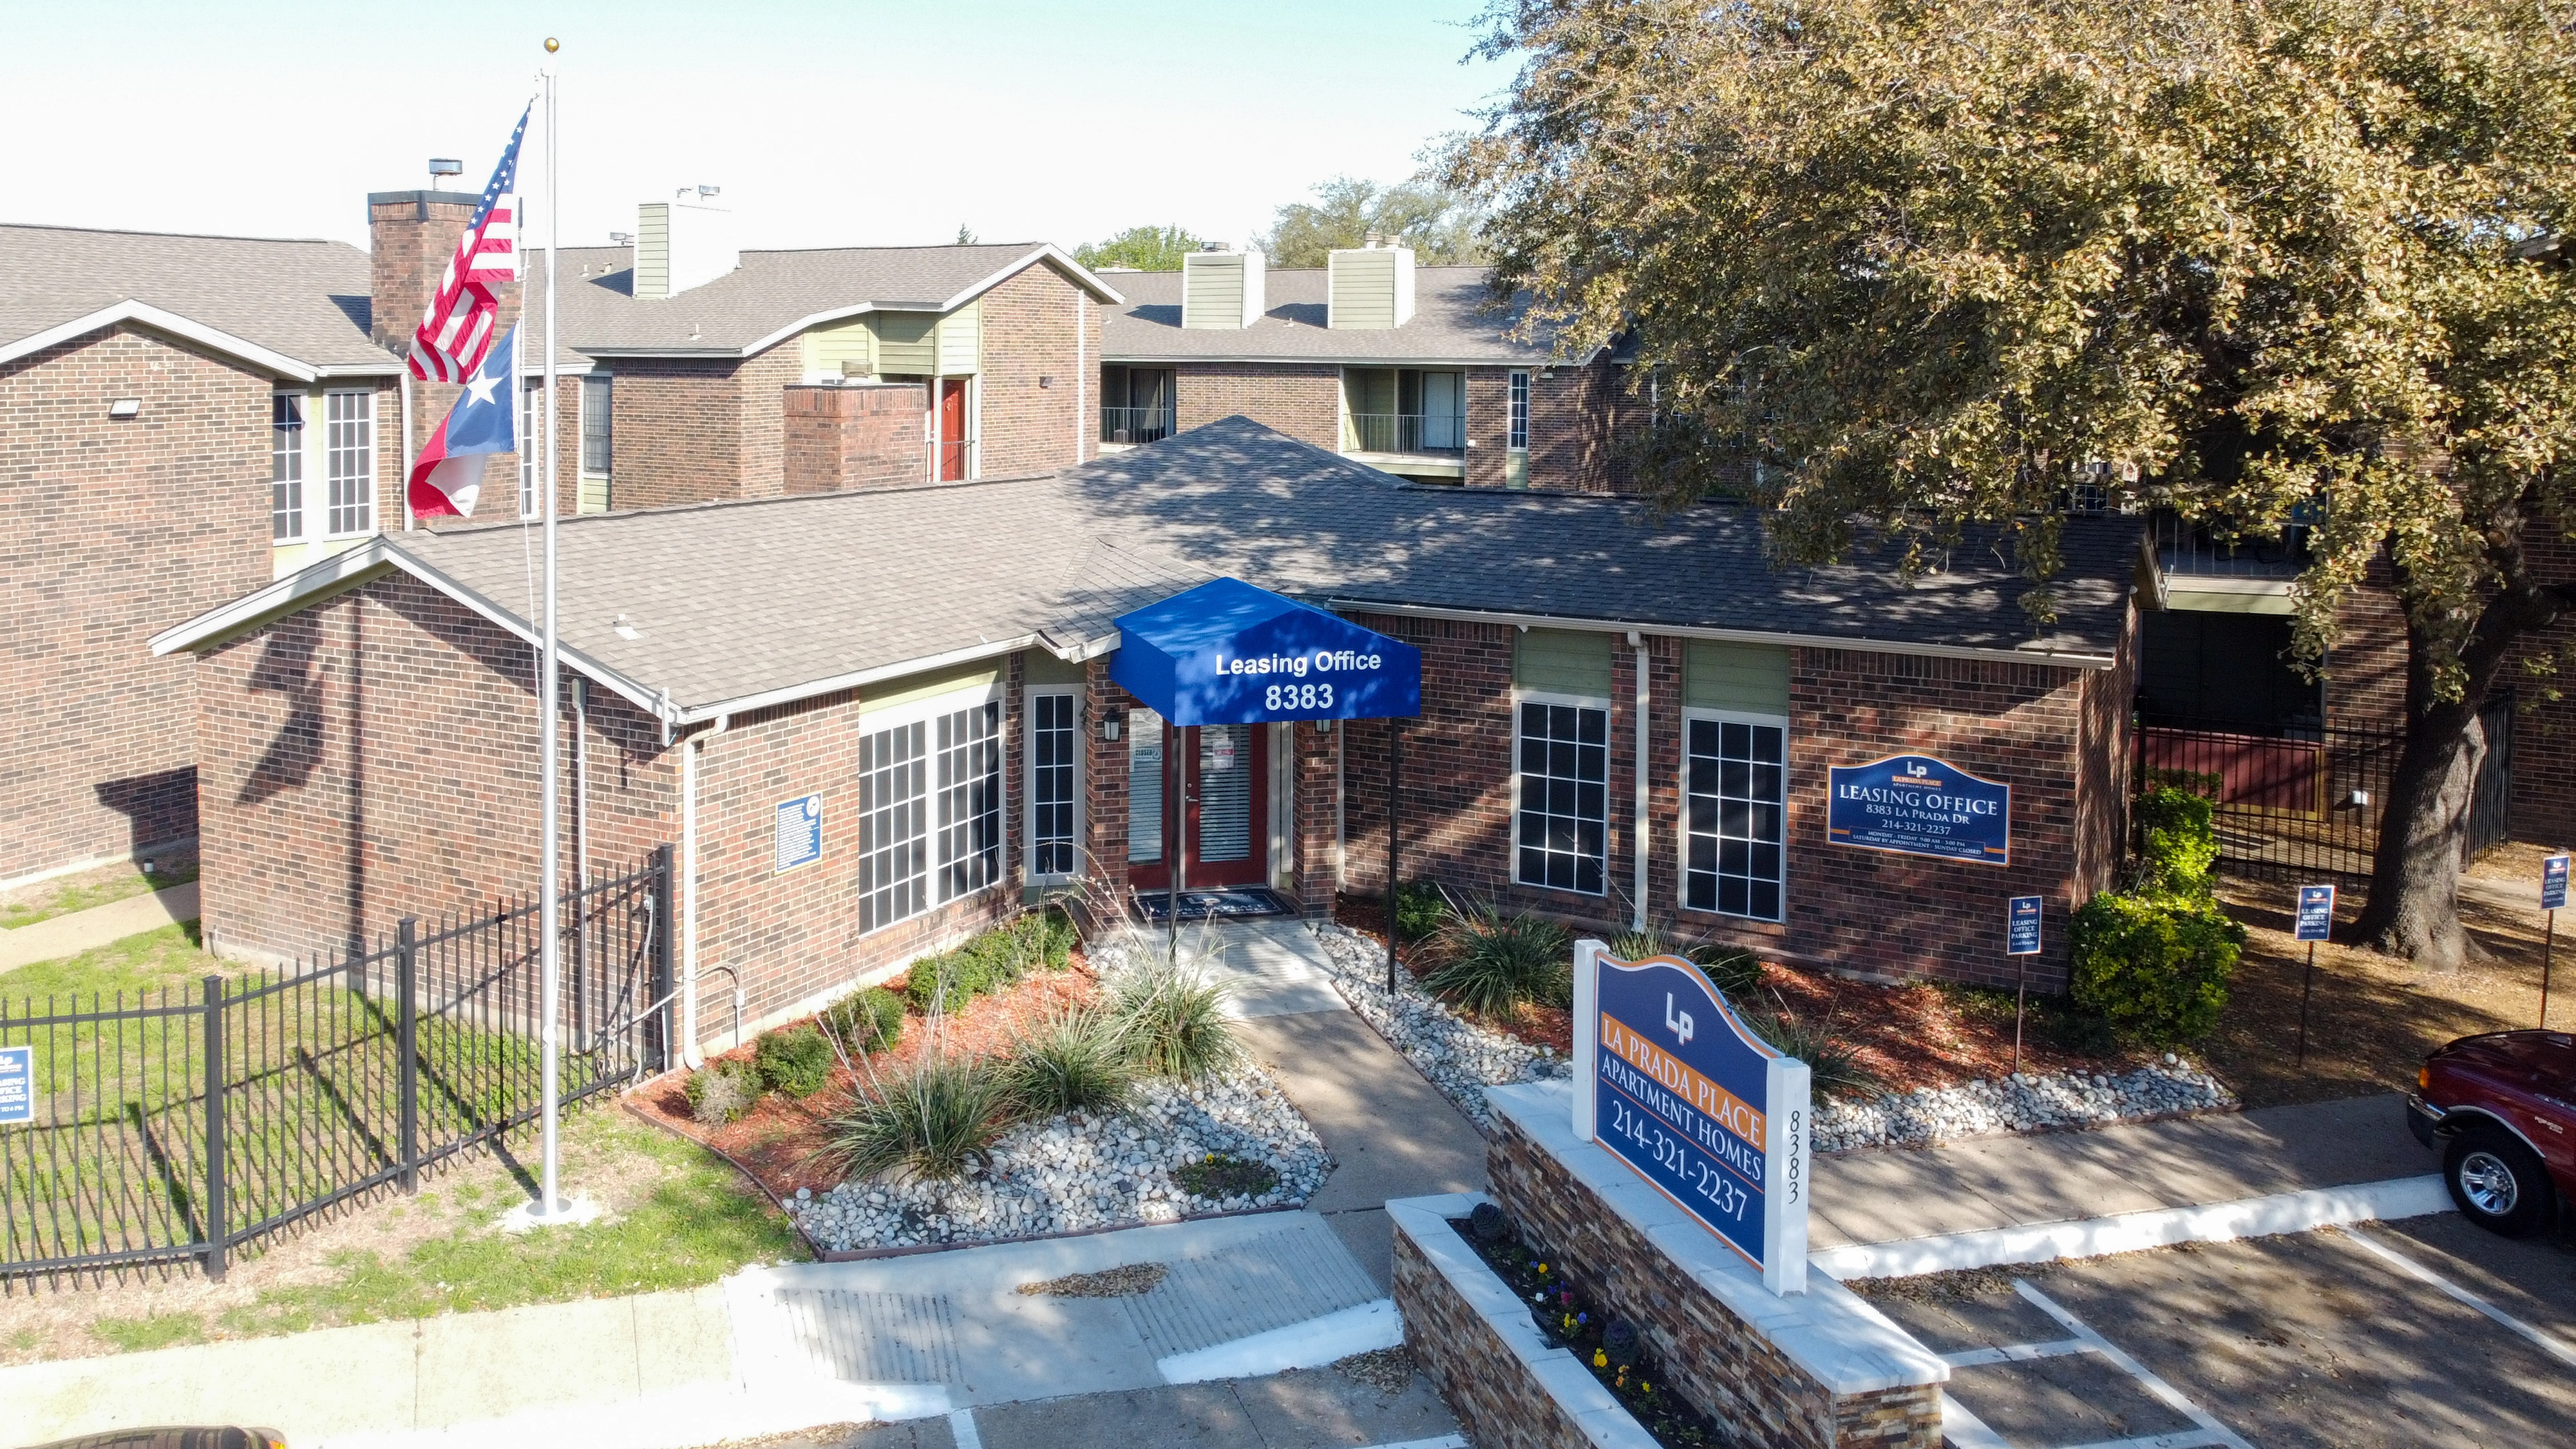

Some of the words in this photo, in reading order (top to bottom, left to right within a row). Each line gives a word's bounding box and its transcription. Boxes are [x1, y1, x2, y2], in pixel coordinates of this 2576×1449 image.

[1216, 653, 1307, 677] Leasing
[1314, 651, 1381, 672] Office
[1265, 683, 1334, 711] 8383
[1839, 784, 1920, 807] LEASING
[1926, 794, 1997, 816] OFFICE
[1866, 804, 1892, 815] 8383
[1895, 808, 1909, 818] LA
[1912, 809, 1949, 822] PRADA
[1953, 813, 1970, 825] DR
[1882, 819, 1951, 835] 214-321-2237
[1889, 838, 1929, 849] APPOINTMENT
[1604, 1018, 1625, 1056] LA
[1629, 1034, 1692, 1101] PRADA
[1697, 1079, 1760, 1147] PLACE
[1602, 1054, 1694, 1133] APARTMENT
[1698, 1117, 1761, 1181] HOMES
[1613, 1100, 1748, 1222] 214-321-2237
[1788, 1110, 1801, 1205] 8383
